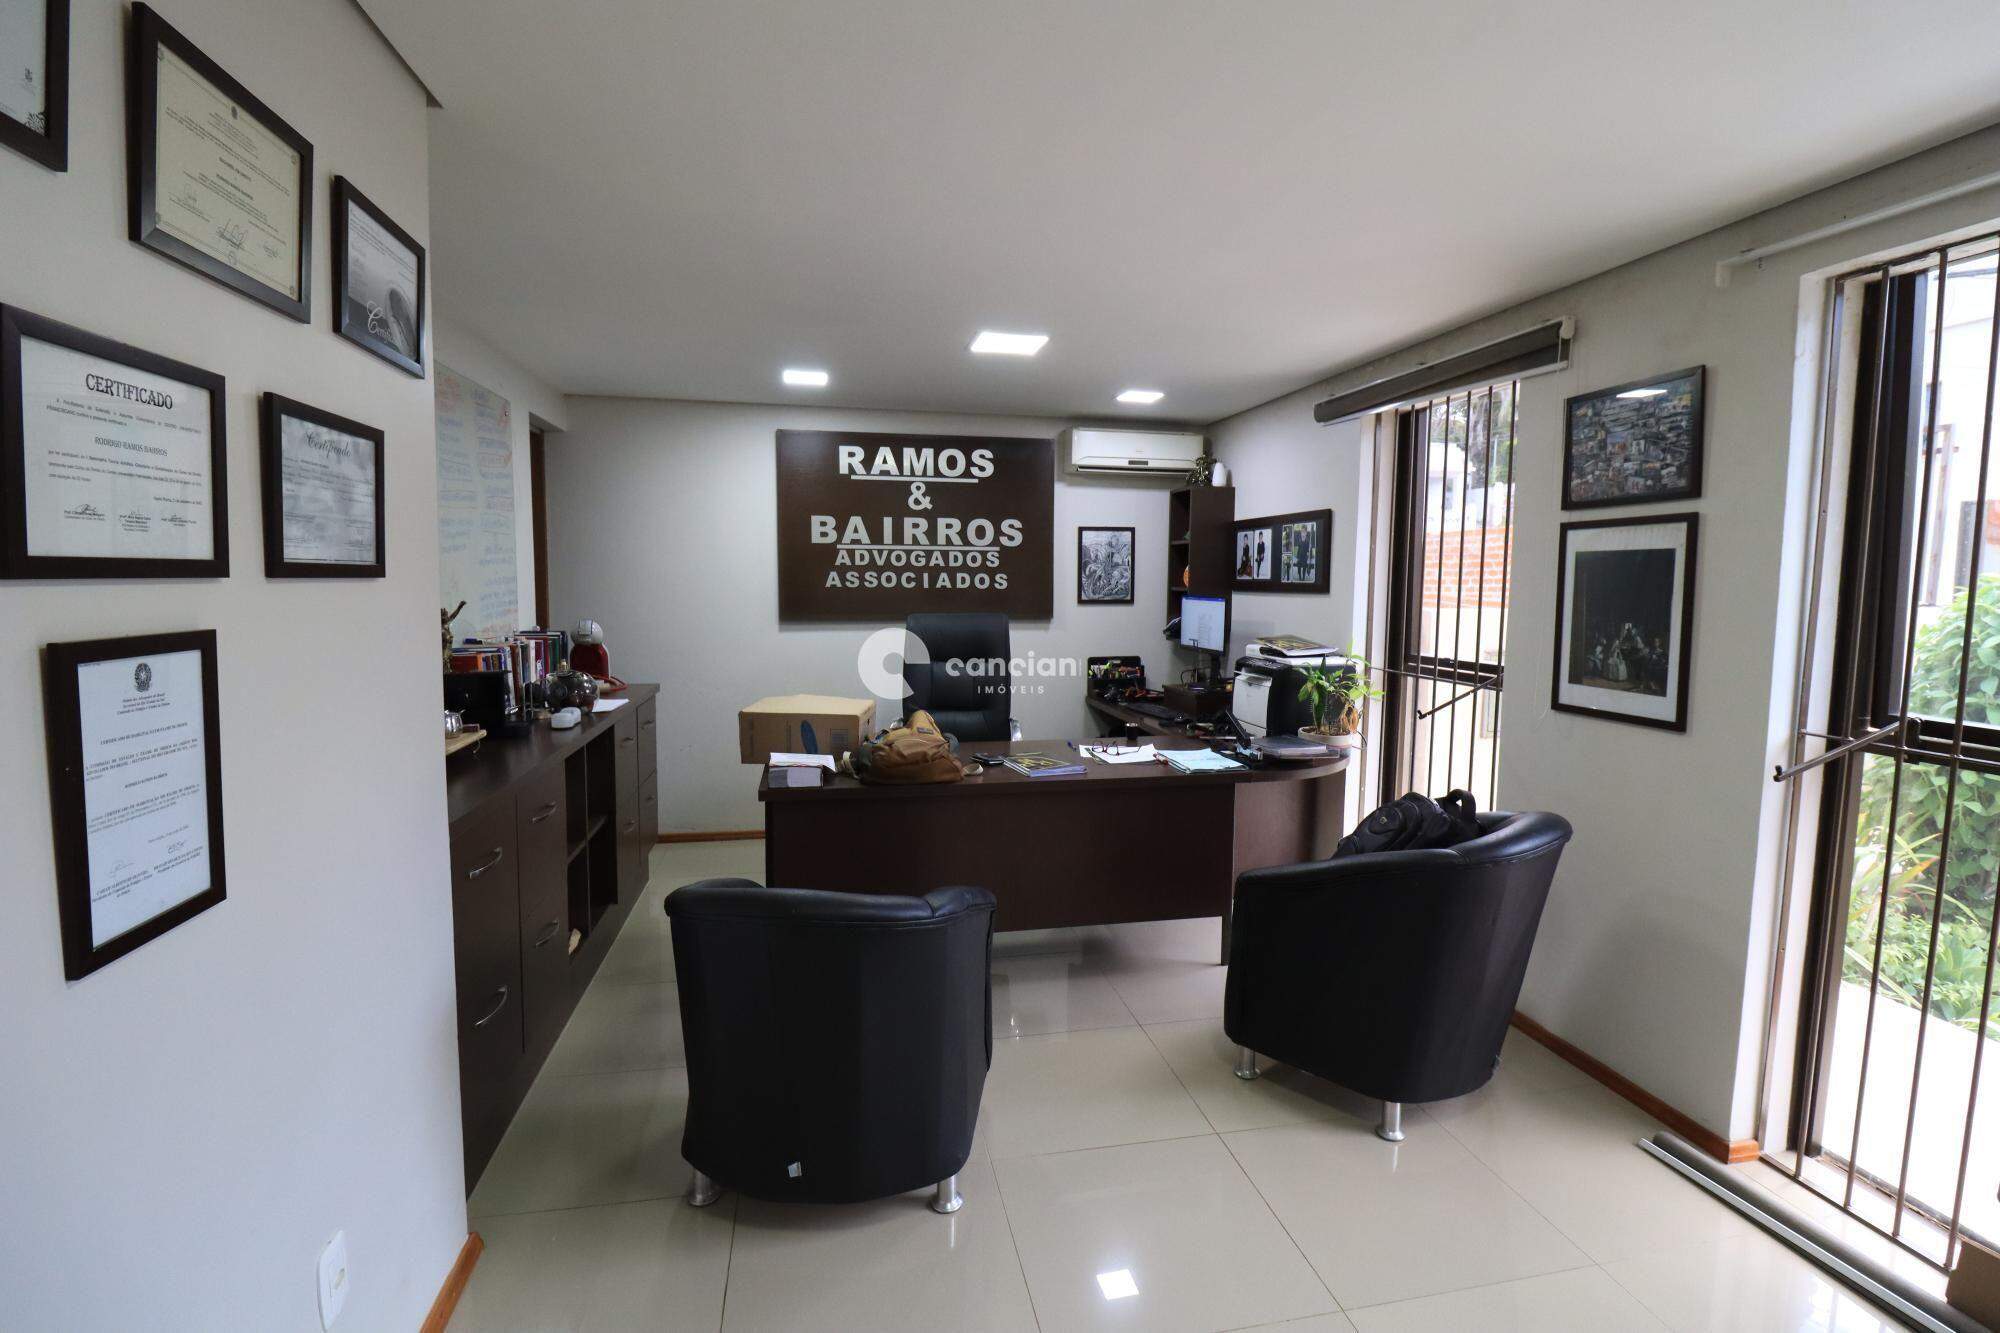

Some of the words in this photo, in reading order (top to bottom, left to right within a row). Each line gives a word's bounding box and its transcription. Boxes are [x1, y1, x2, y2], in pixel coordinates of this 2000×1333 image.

[85, 373, 173, 410] CERTIFICADO
[838, 445, 995, 478] RAMOS
[907, 481, 933, 511] &
[811, 514, 1023, 547] BAIRROS
[834, 549, 1000, 568] ADVOGADOS
[825, 571, 1008, 590] ASSOCIADOS
